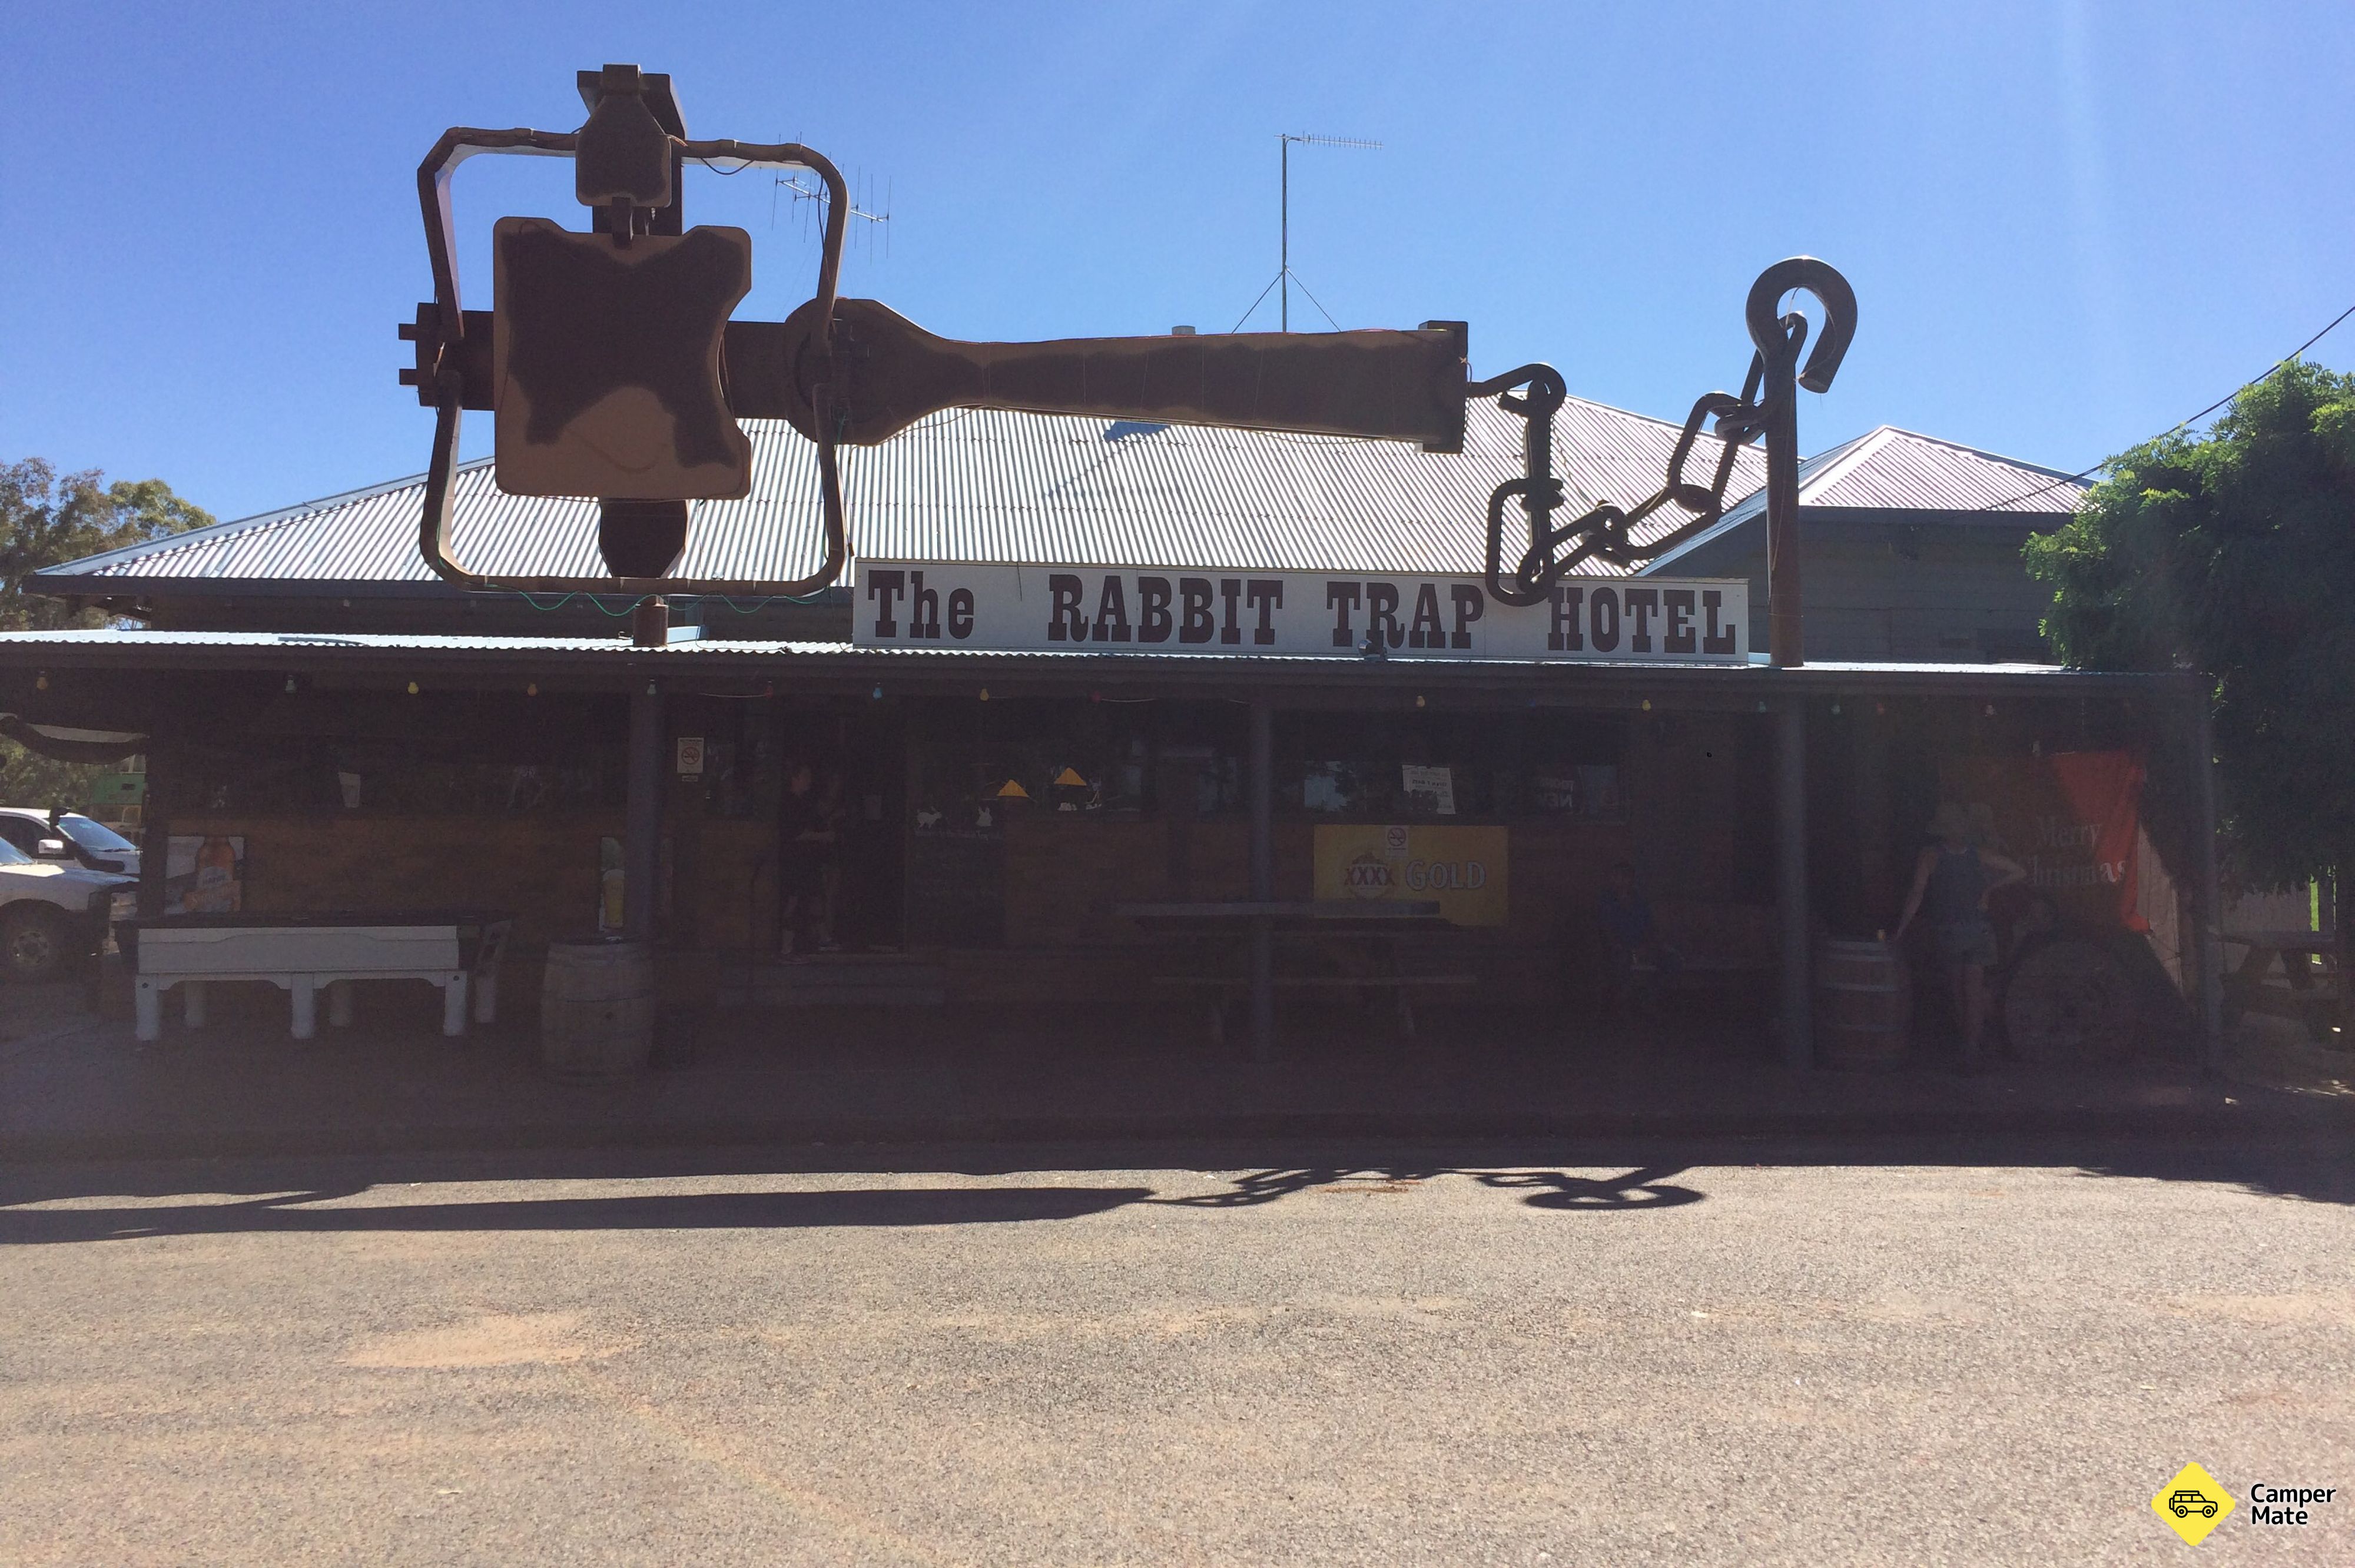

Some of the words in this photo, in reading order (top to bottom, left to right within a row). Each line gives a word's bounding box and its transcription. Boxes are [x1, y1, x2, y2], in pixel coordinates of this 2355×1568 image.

[868, 569, 974, 639] The
[1047, 573, 1284, 645] RABBIT
[1326, 581, 1485, 650] TRAP
[1547, 586, 1736, 655] HOTEL
[1344, 866, 1396, 885] XXXX
[1405, 859, 1487, 891] GOLD
